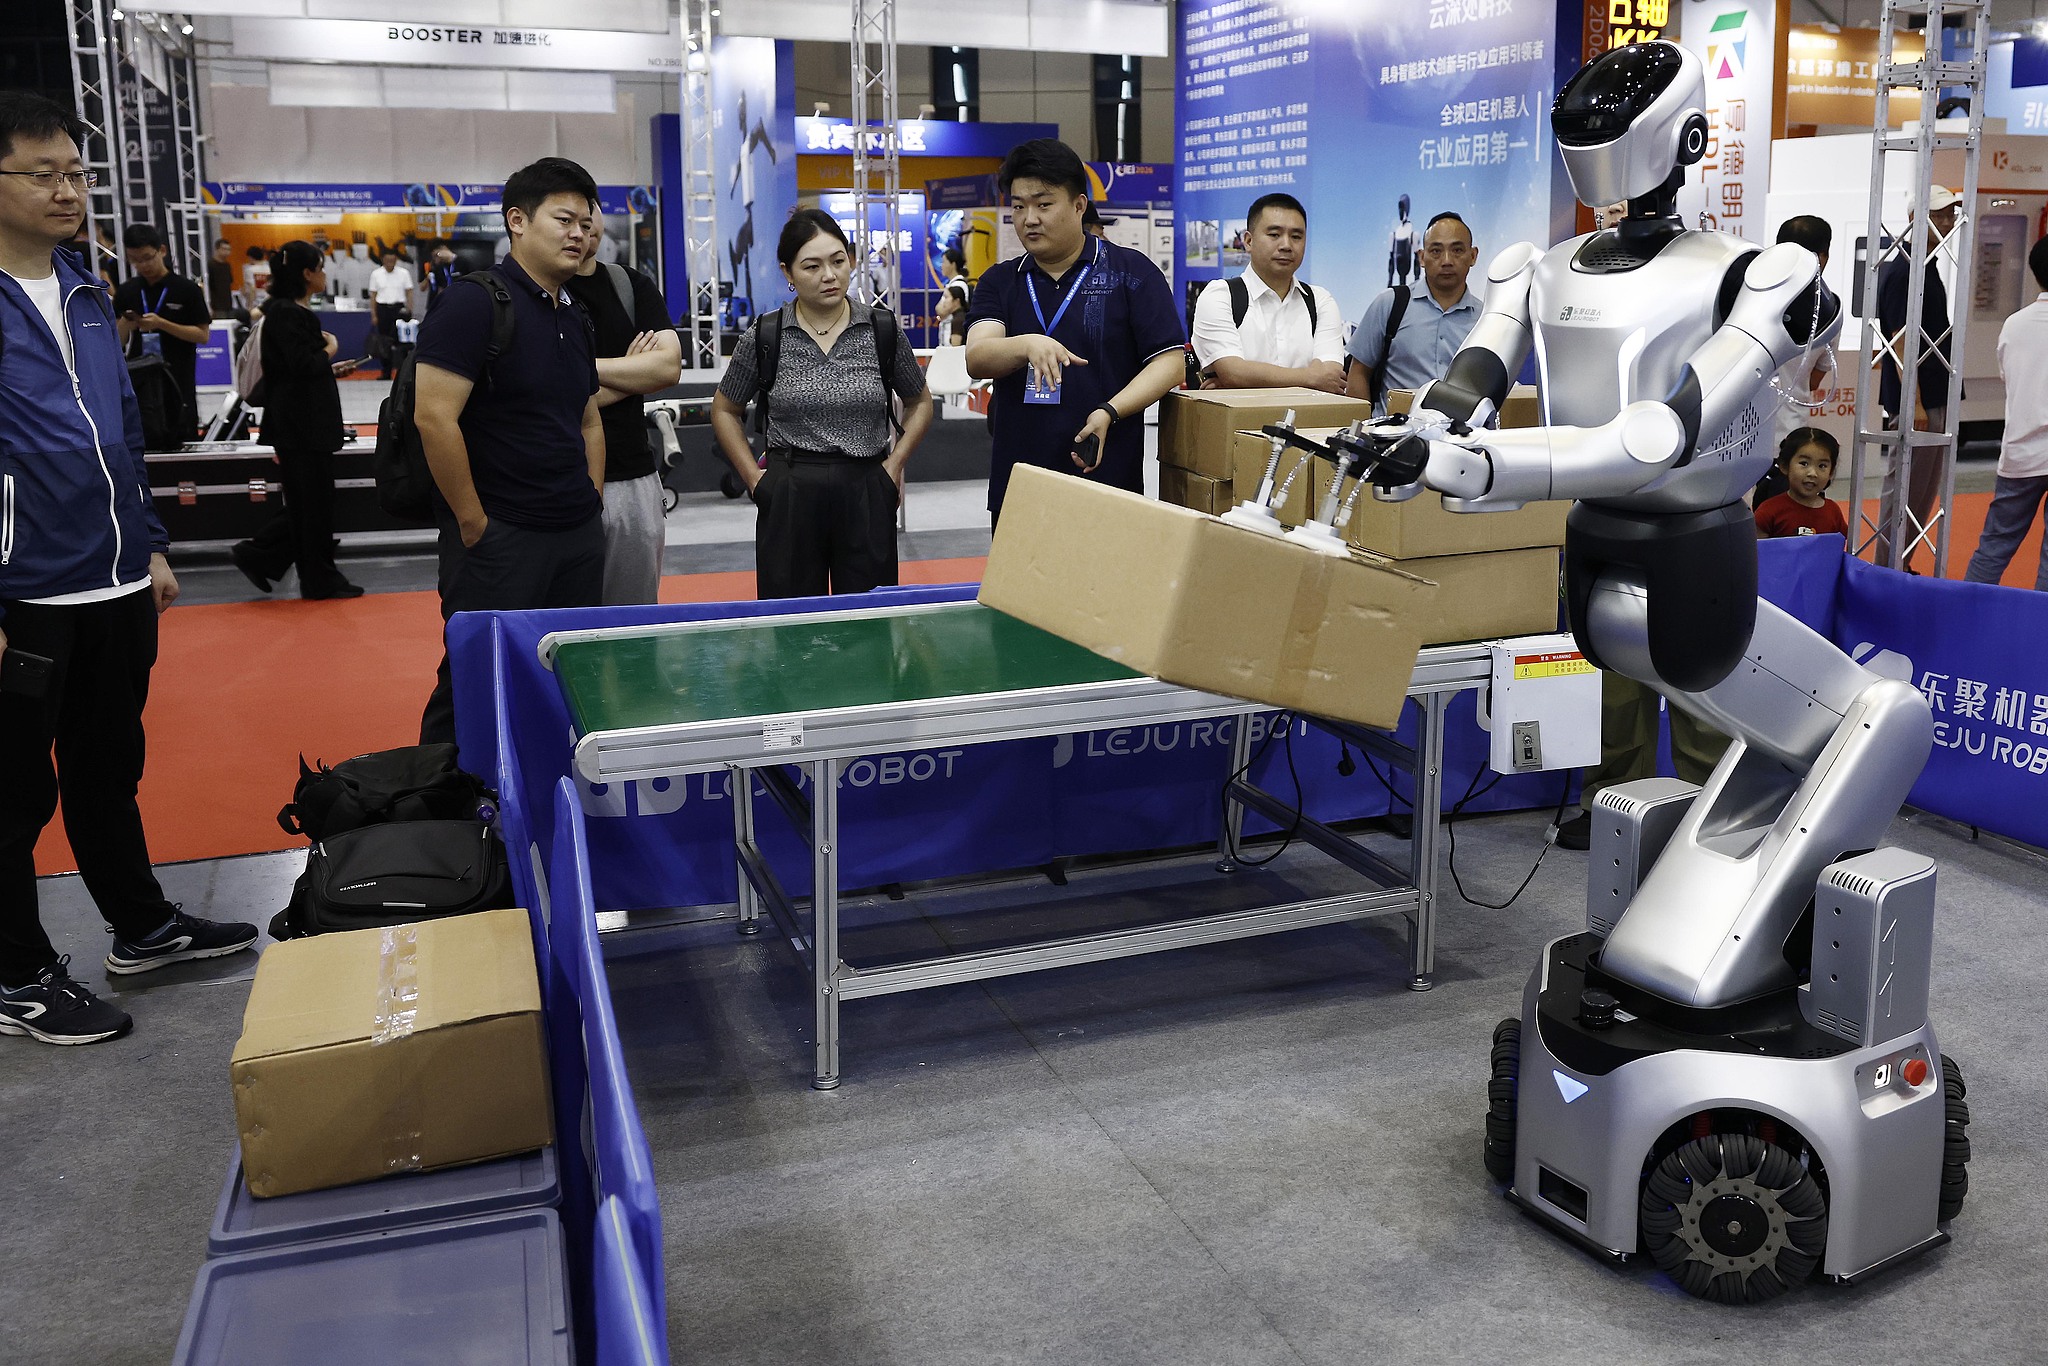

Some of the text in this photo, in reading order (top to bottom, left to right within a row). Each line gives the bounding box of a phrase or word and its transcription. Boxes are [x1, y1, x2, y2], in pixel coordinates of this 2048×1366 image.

[388, 27, 551, 46] BOOSTER 加速进化
[1380, 40, 1545, 85] 具身智能技术创新与行业应用引领者
[1440, 93, 1530, 127] 全球四足机器人
[1419, 130, 1529, 170] 行业应用第一
[1810, 404, 1856, 417] DL-OK
[1087, 724, 1180, 757] LEJU
[1933, 721, 2048, 775] EJU ROB
[836, 750, 963, 789] OBOT
